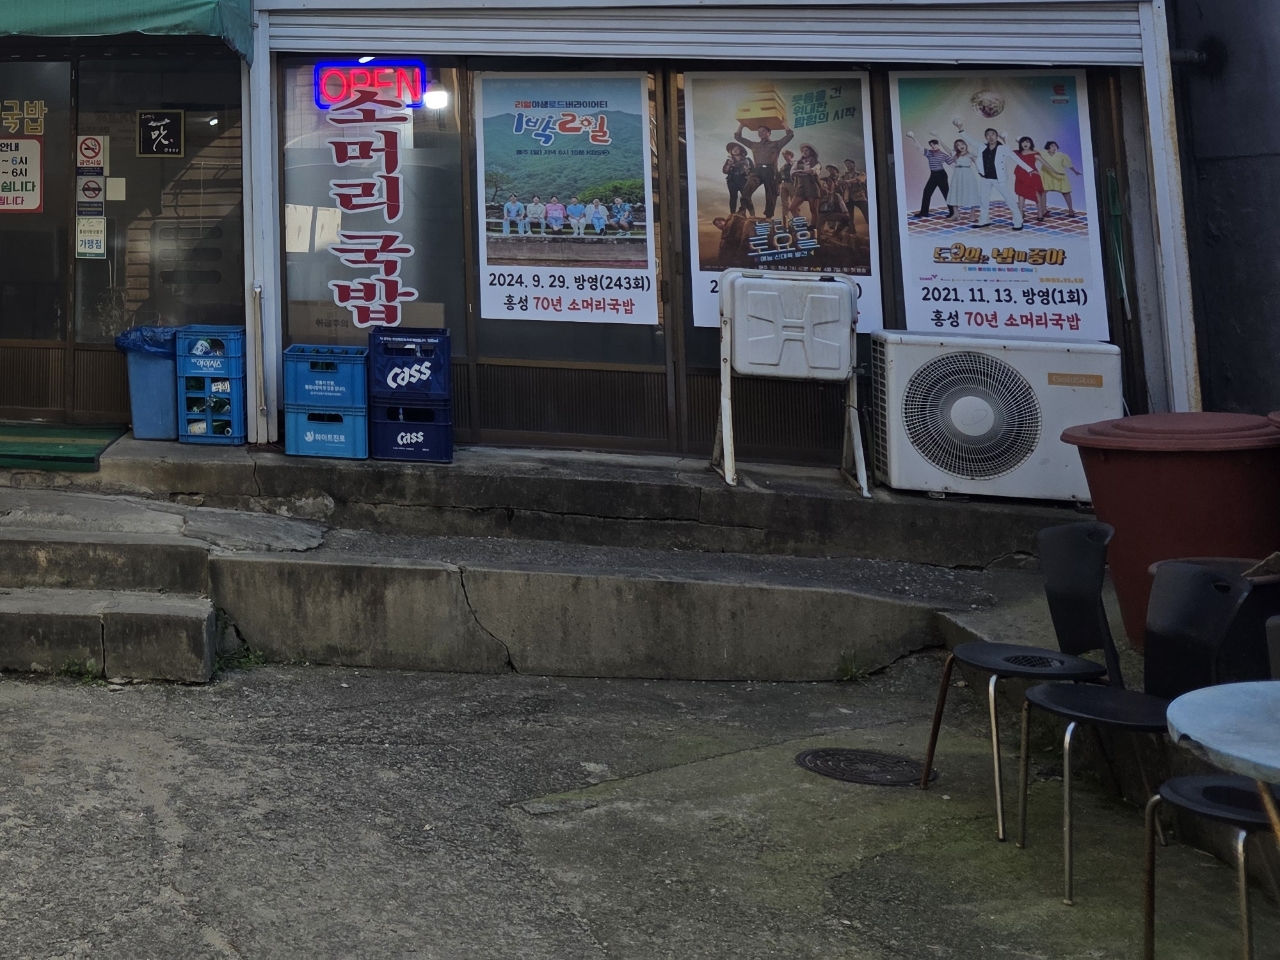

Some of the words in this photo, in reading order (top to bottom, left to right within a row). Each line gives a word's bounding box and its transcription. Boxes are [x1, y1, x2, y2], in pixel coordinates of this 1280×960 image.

[321, 68, 421, 104] OPEN
[792, 90, 827, 106] 웃음을
[793, 101, 828, 117] 위대한
[793, 113, 829, 129] 탐험의
[832, 106, 857, 121] 시작
[0, 143, 19, 152] 안내
[11, 156, 28, 166] 6시
[11, 168, 28, 177] 6시
[1, 181, 36, 192] 쉽니다
[79, 239, 102, 249] 가맹점
[488, 273, 528, 288] 2024.
[532, 274, 545, 289] 9.
[549, 274, 570, 289] 29.
[574, 274, 651, 292] 방영(243회)
[504, 294, 528, 311] 홍성
[533, 296, 563, 312] 70년
[567, 297, 635, 315] 소머리국밥
[922, 287, 965, 303] 2021.
[969, 288, 990, 303] 11.
[994, 289, 1017, 304] 13.
[1022, 288, 1088, 306] 방영(1회)
[315, 318, 349, 328] 취급주의
[931, 310, 960, 328] 홍성
[964, 311, 999, 328] 70년
[1004, 312, 1082, 330] 소머리국밥
[315, 433, 346, 442] 하이트진로
